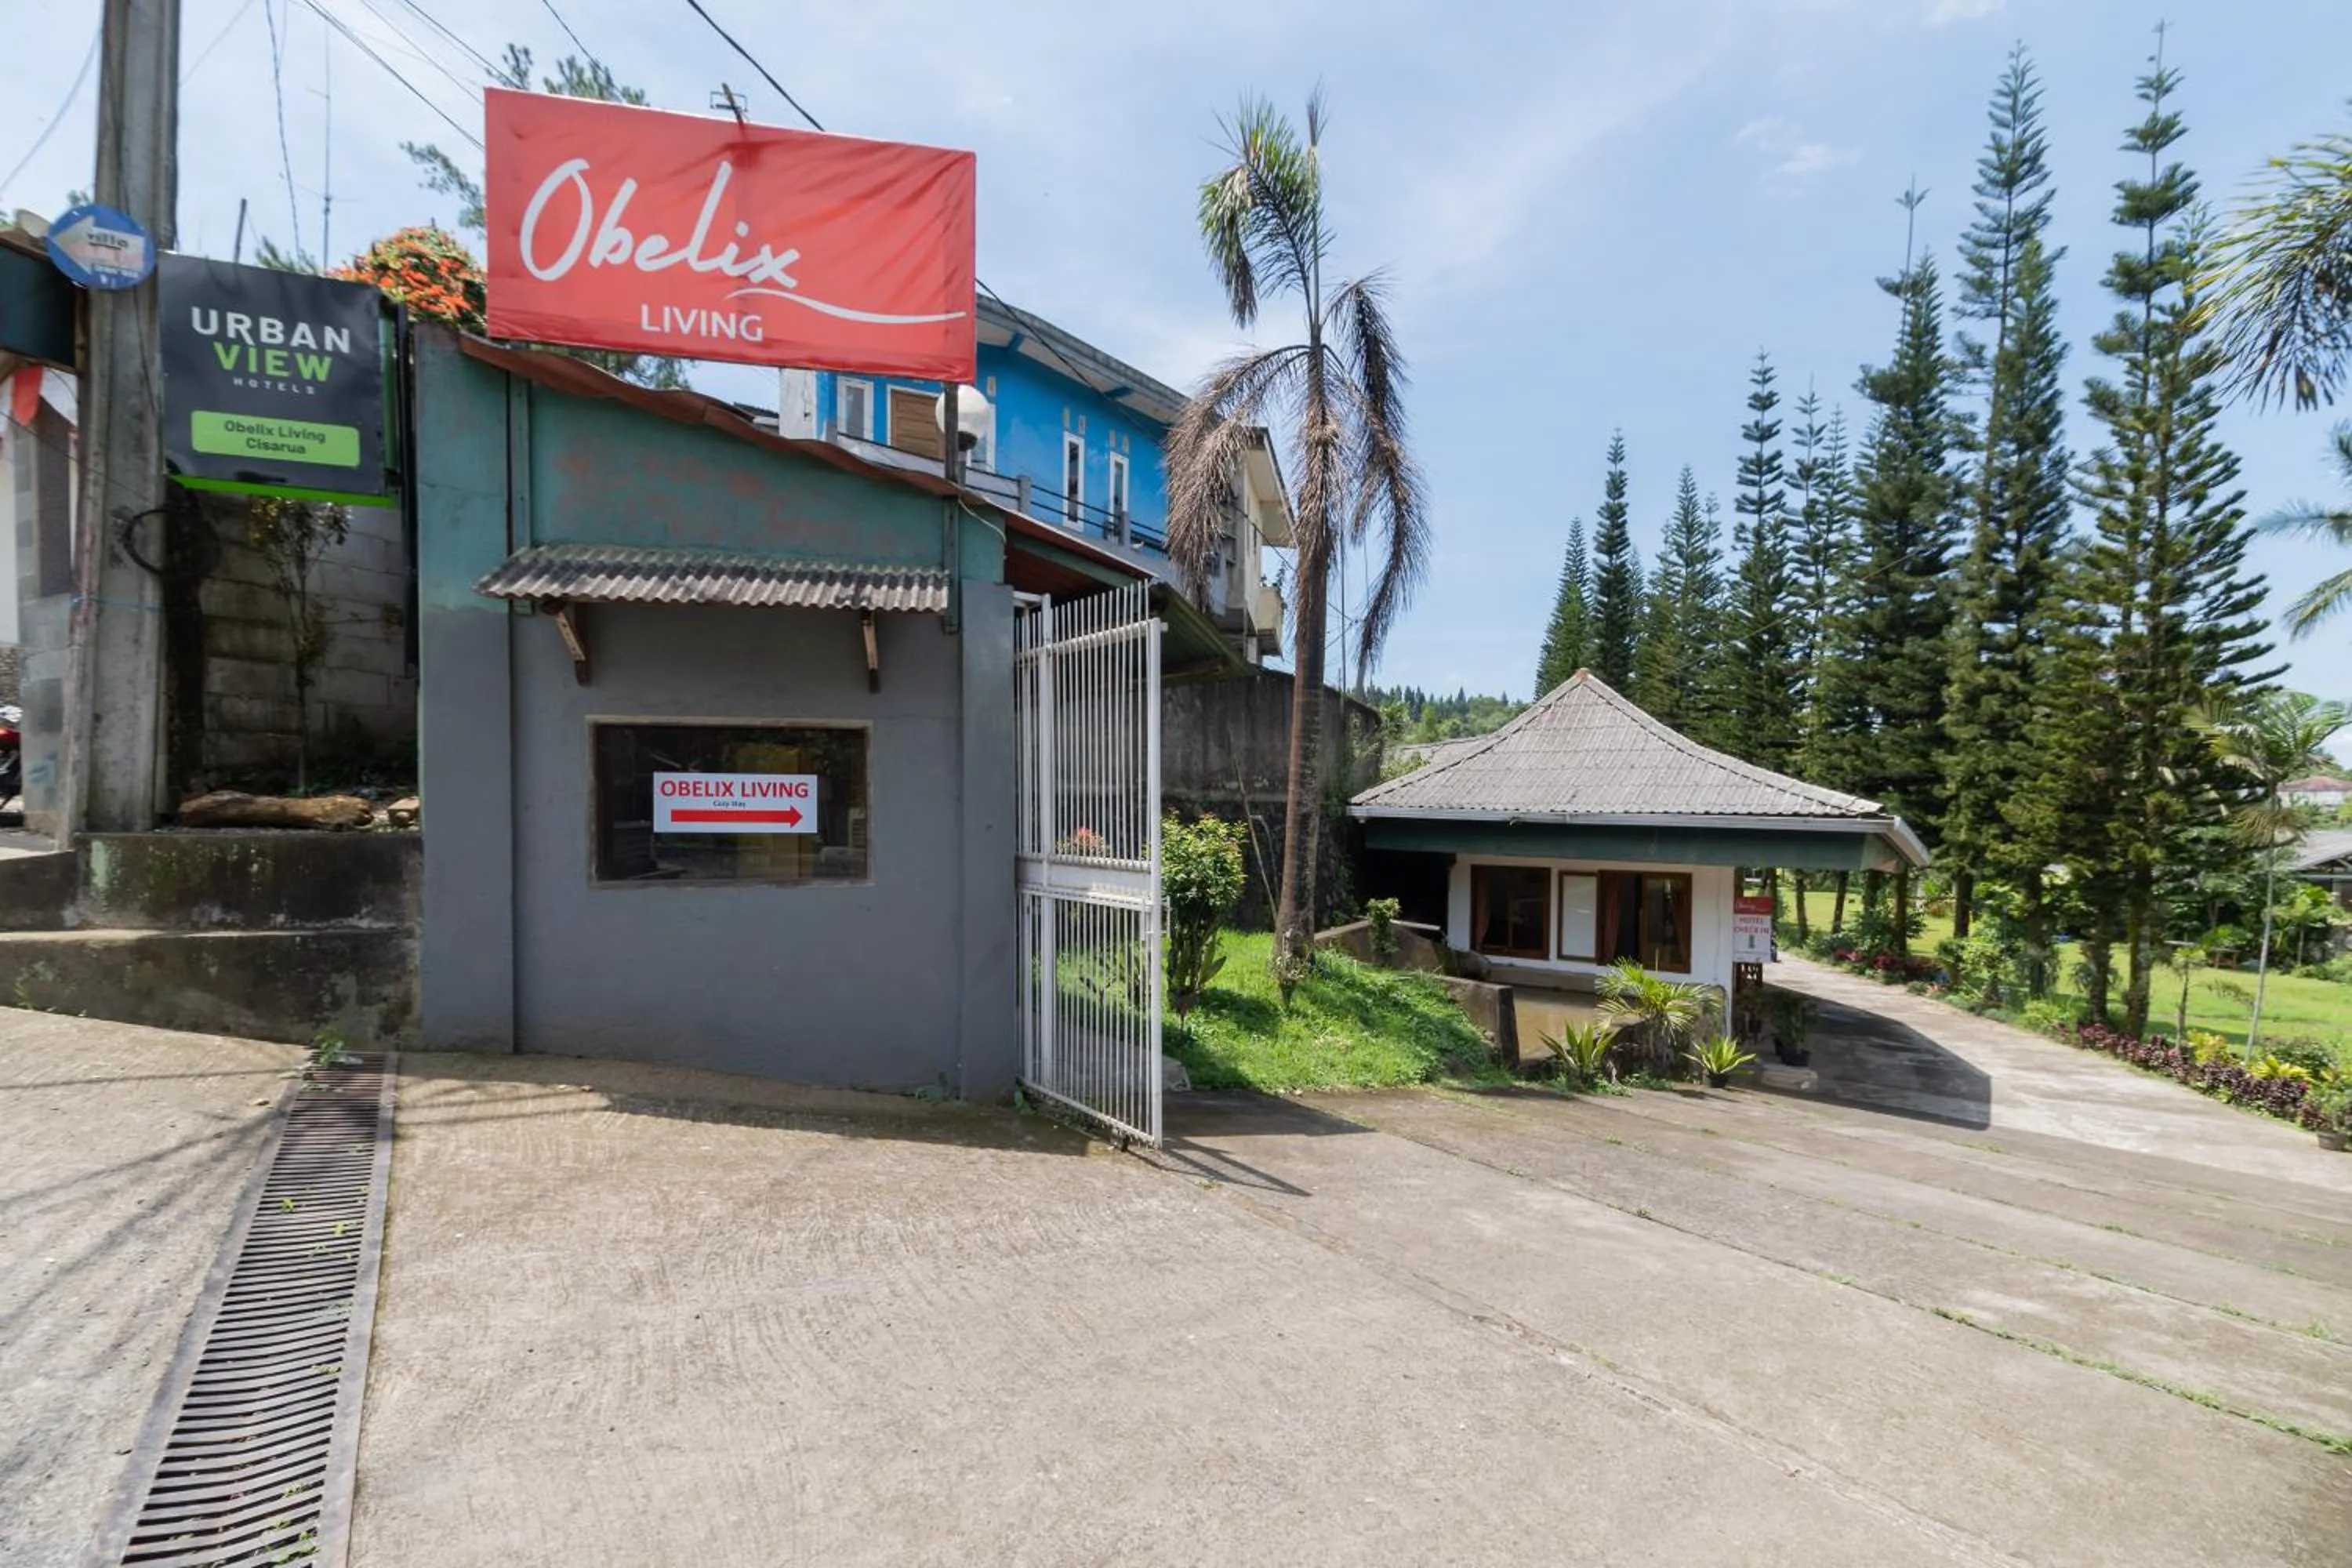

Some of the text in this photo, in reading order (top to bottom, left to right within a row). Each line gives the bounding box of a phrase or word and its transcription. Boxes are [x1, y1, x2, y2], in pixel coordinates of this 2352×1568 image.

[520, 158, 800, 289] Obelix
[191, 307, 350, 354] URBAN
[641, 303, 764, 343] LIVING
[213, 341, 332, 382] VIEW
[234, 376, 315, 395] HOTELS
[224, 419, 326, 445] Obelix Living
[245, 437, 307, 455] Cisarua
[660, 780, 809, 798] OBELIX LIVING
